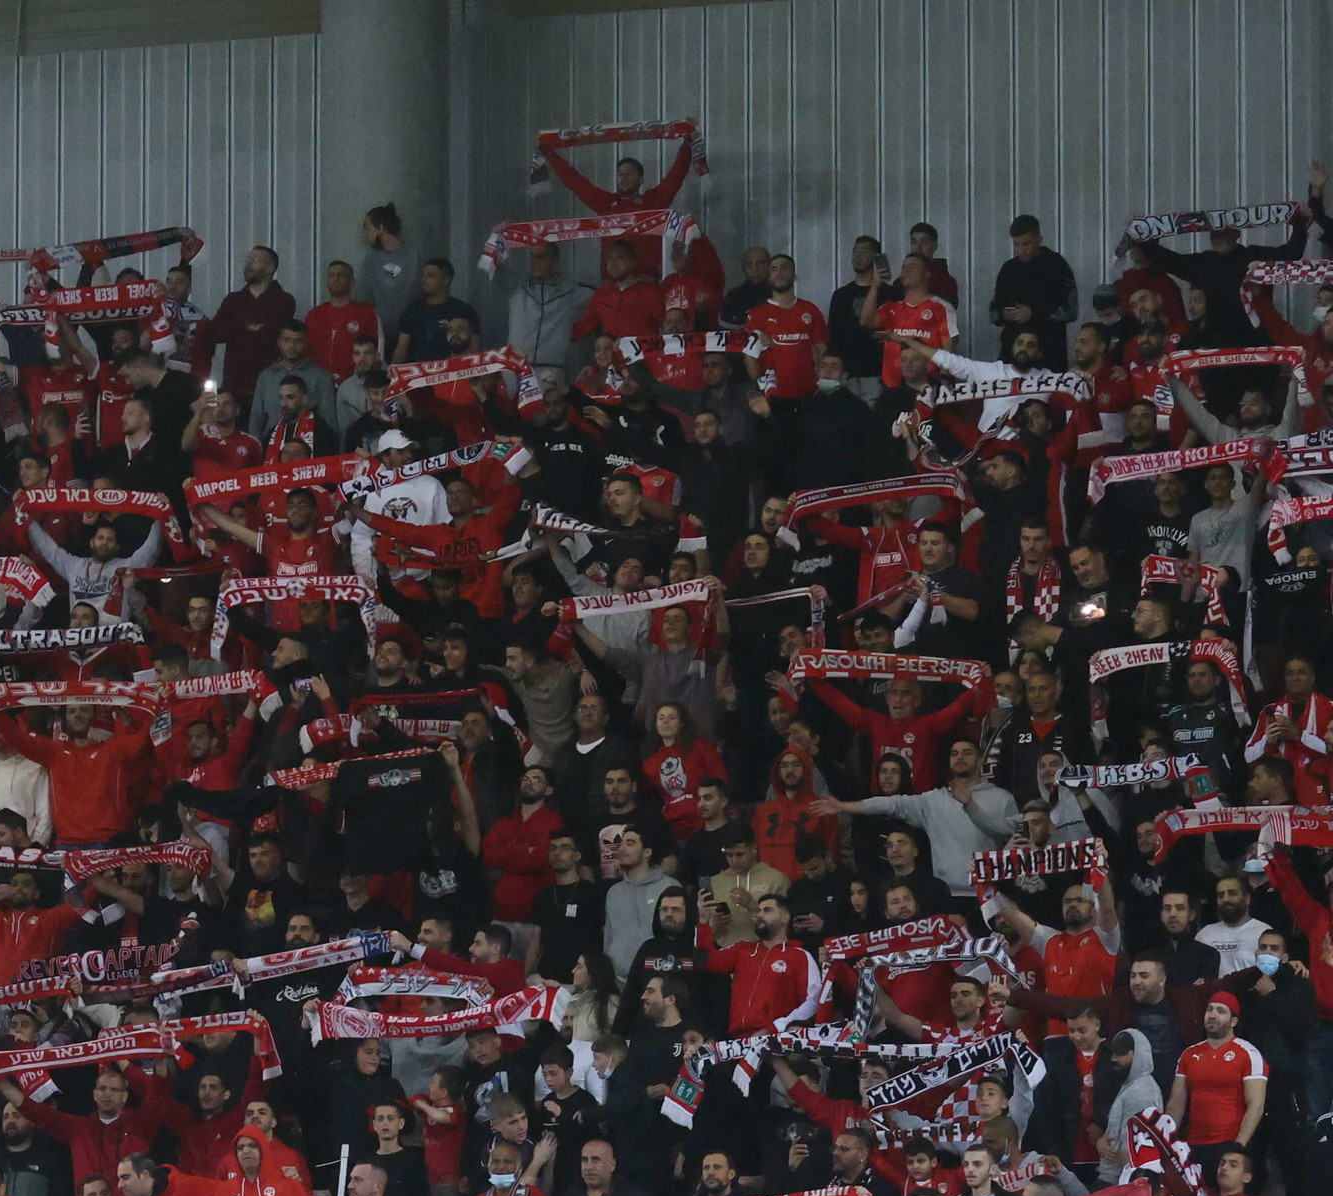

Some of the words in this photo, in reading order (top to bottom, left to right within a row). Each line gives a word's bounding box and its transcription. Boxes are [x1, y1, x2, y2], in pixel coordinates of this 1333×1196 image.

[1208, 203, 1296, 229] TOUR
[95, 290, 120, 305] BEER
[425, 366, 451, 380] BEER
[456, 360, 489, 375] SHEVA
[195, 479, 241, 498] HAPOEL
[250, 474, 279, 491] BEER
[292, 464, 327, 486] SHEVA
[27, 489, 59, 505] שבע
[62, 489, 91, 503] באר
[235, 575, 278, 588] BEER
[306, 574, 361, 587] SHEVA
[1264, 570, 1317, 587] EUROPA
[229, 588, 292, 608] שבע
[322, 585, 366, 602] באר
[1018, 735, 1032, 745] 23
[49, 1043, 86, 1057] באר
[93, 1038, 137, 1052] הפועל
[9, 1049, 45, 1064] שבע
